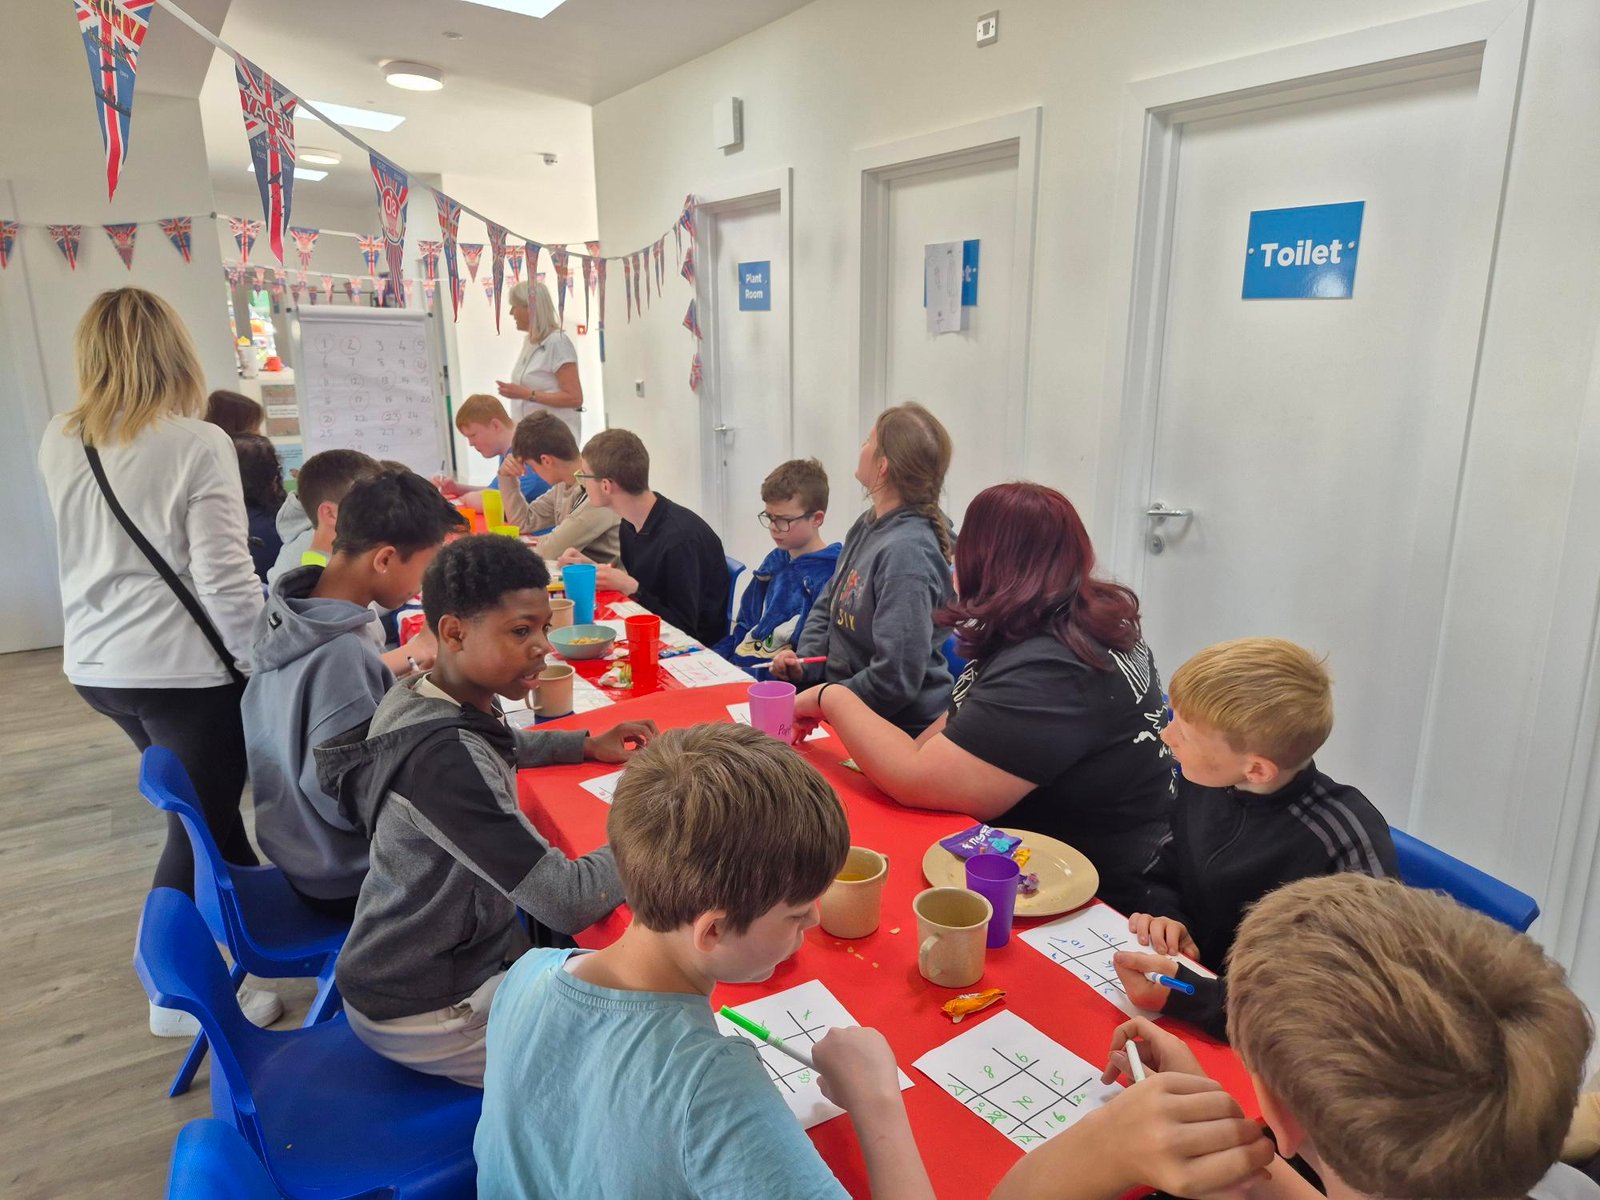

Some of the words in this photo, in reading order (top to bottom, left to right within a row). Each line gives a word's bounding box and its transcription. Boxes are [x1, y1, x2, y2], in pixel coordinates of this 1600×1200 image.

[1260, 239, 1343, 267] Toilet
[745, 273, 762, 284] Plant
[745, 289, 763, 299] Room
[1015, 1052, 1029, 1063] 6
[983, 1065, 995, 1079] 8
[1049, 1070, 1065, 1087] 15
[1045, 1111, 1067, 1129] 16
